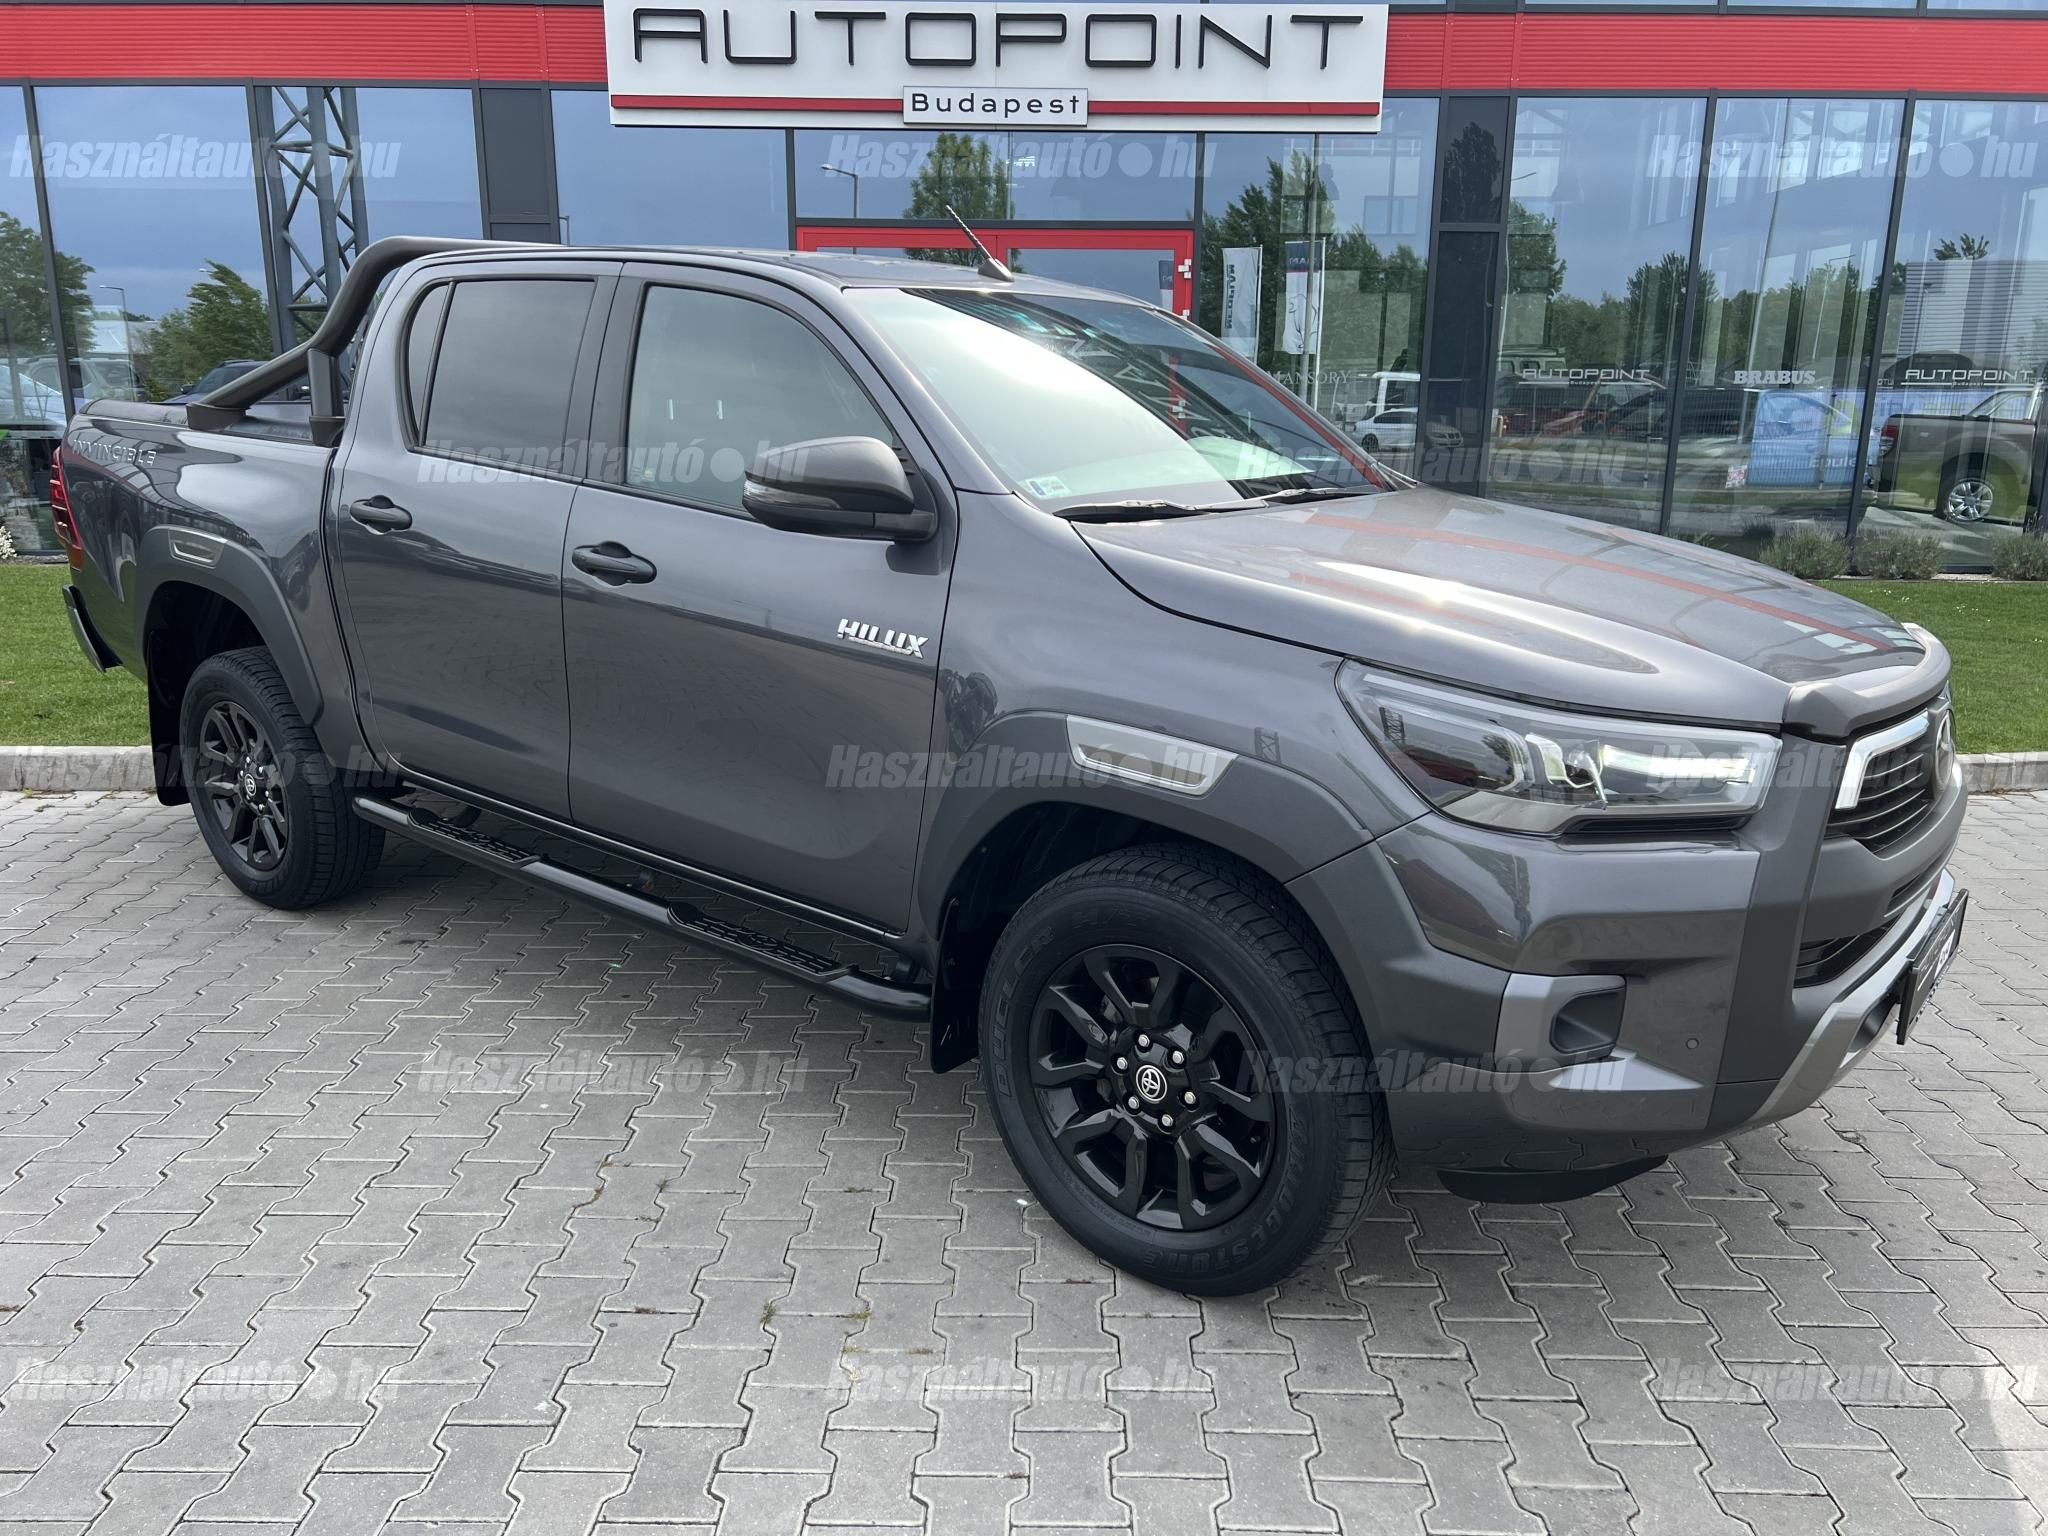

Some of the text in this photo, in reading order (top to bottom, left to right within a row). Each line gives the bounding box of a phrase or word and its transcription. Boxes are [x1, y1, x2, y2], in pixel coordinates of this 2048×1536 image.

[633, 8, 1363, 70] AUTOPOINT
[912, 93, 1079, 118] Budapest
[1522, 368, 1650, 380] AUTOPOINT
[1733, 370, 1816, 385] BRABUS
[1905, 369, 2034, 381] AUTOPOINT
[72, 439, 157, 466] INVINCIBLE
[837, 618, 929, 659] HILUX
